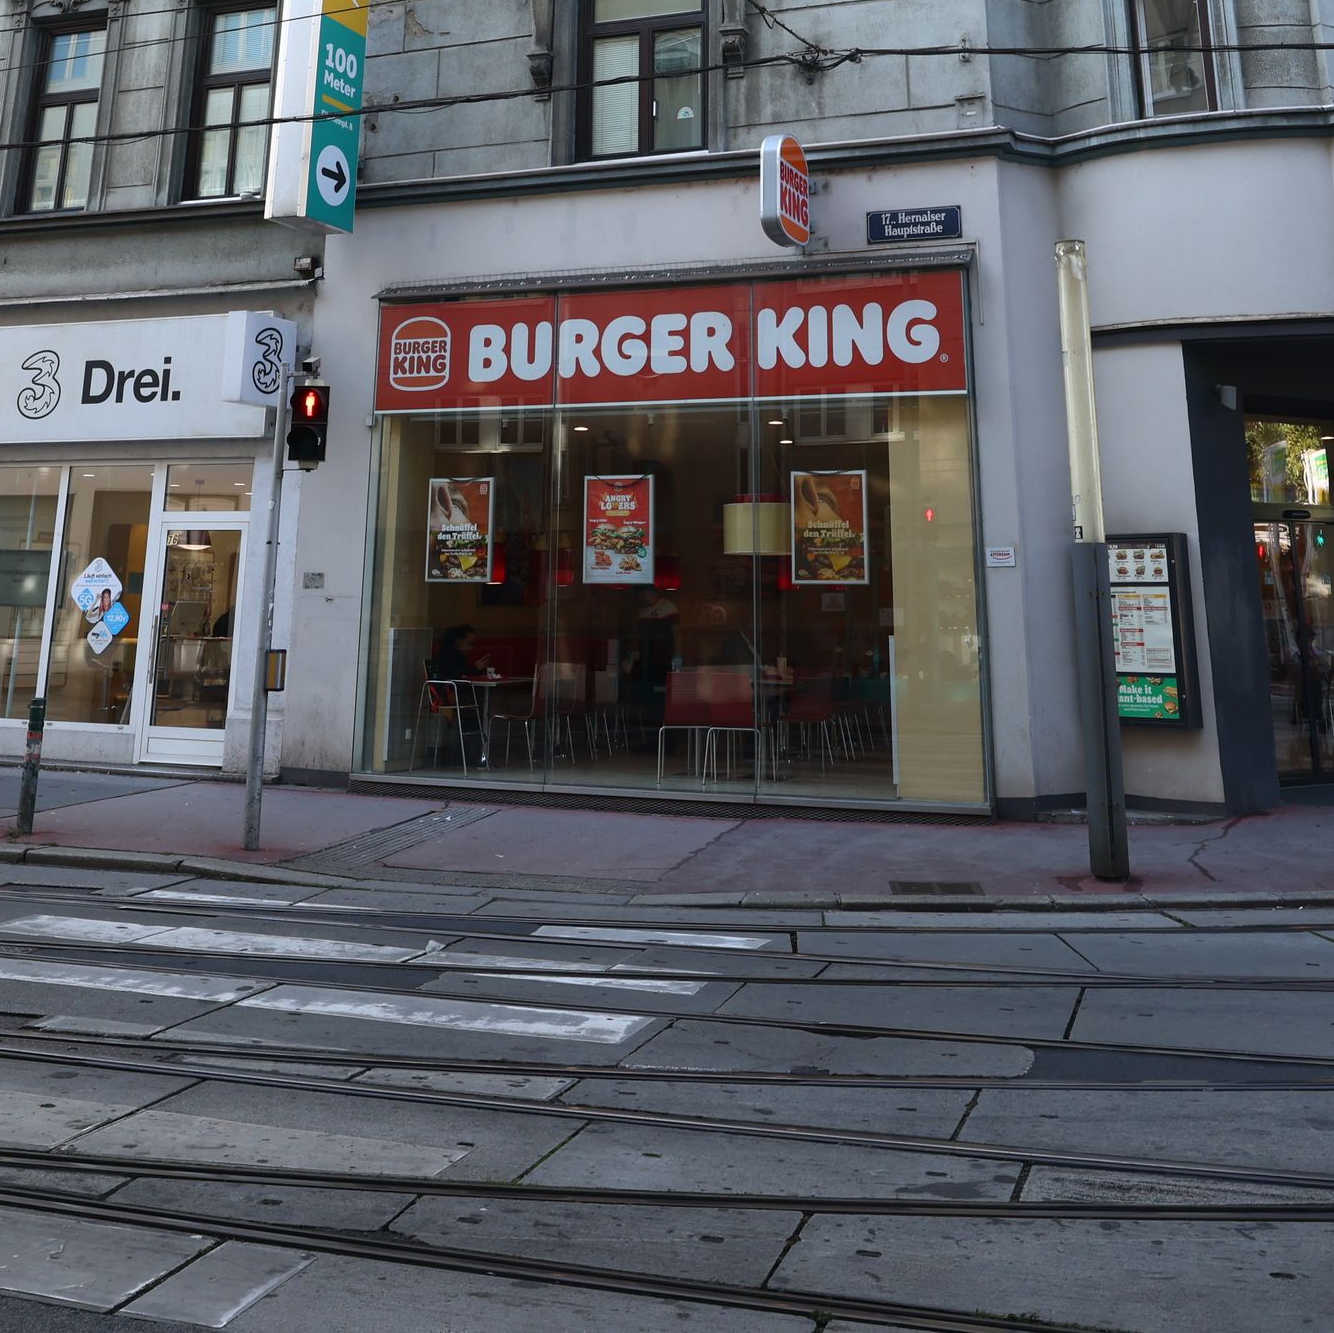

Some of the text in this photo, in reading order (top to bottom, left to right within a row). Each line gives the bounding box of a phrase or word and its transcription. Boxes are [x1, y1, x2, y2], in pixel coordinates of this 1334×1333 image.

[325, 43, 358, 80] 100
[324, 70, 356, 99] Meter
[349, 122, 354, 131] 8
[780, 160, 809, 199] BURGER
[780, 182, 809, 227] KING
[898, 211, 946, 224] Hernalser
[884, 222, 944, 238] Hauptstraße
[394, 340, 447, 355] BURGER
[468, 299, 941, 383] BURGER KING
[393, 354, 447, 375] KING
[17, 349, 181, 419] 3 Drei.
[605, 494, 633, 503] ANGRY
[441, 522, 478, 532] Schnüffel
[807, 519, 850, 528] Schnüffel
[803, 529, 819, 538] den
[79, 595, 92, 606] 5G
[1119, 685, 1152, 694] Make it
[1118, 695, 1163, 704] ant-based
